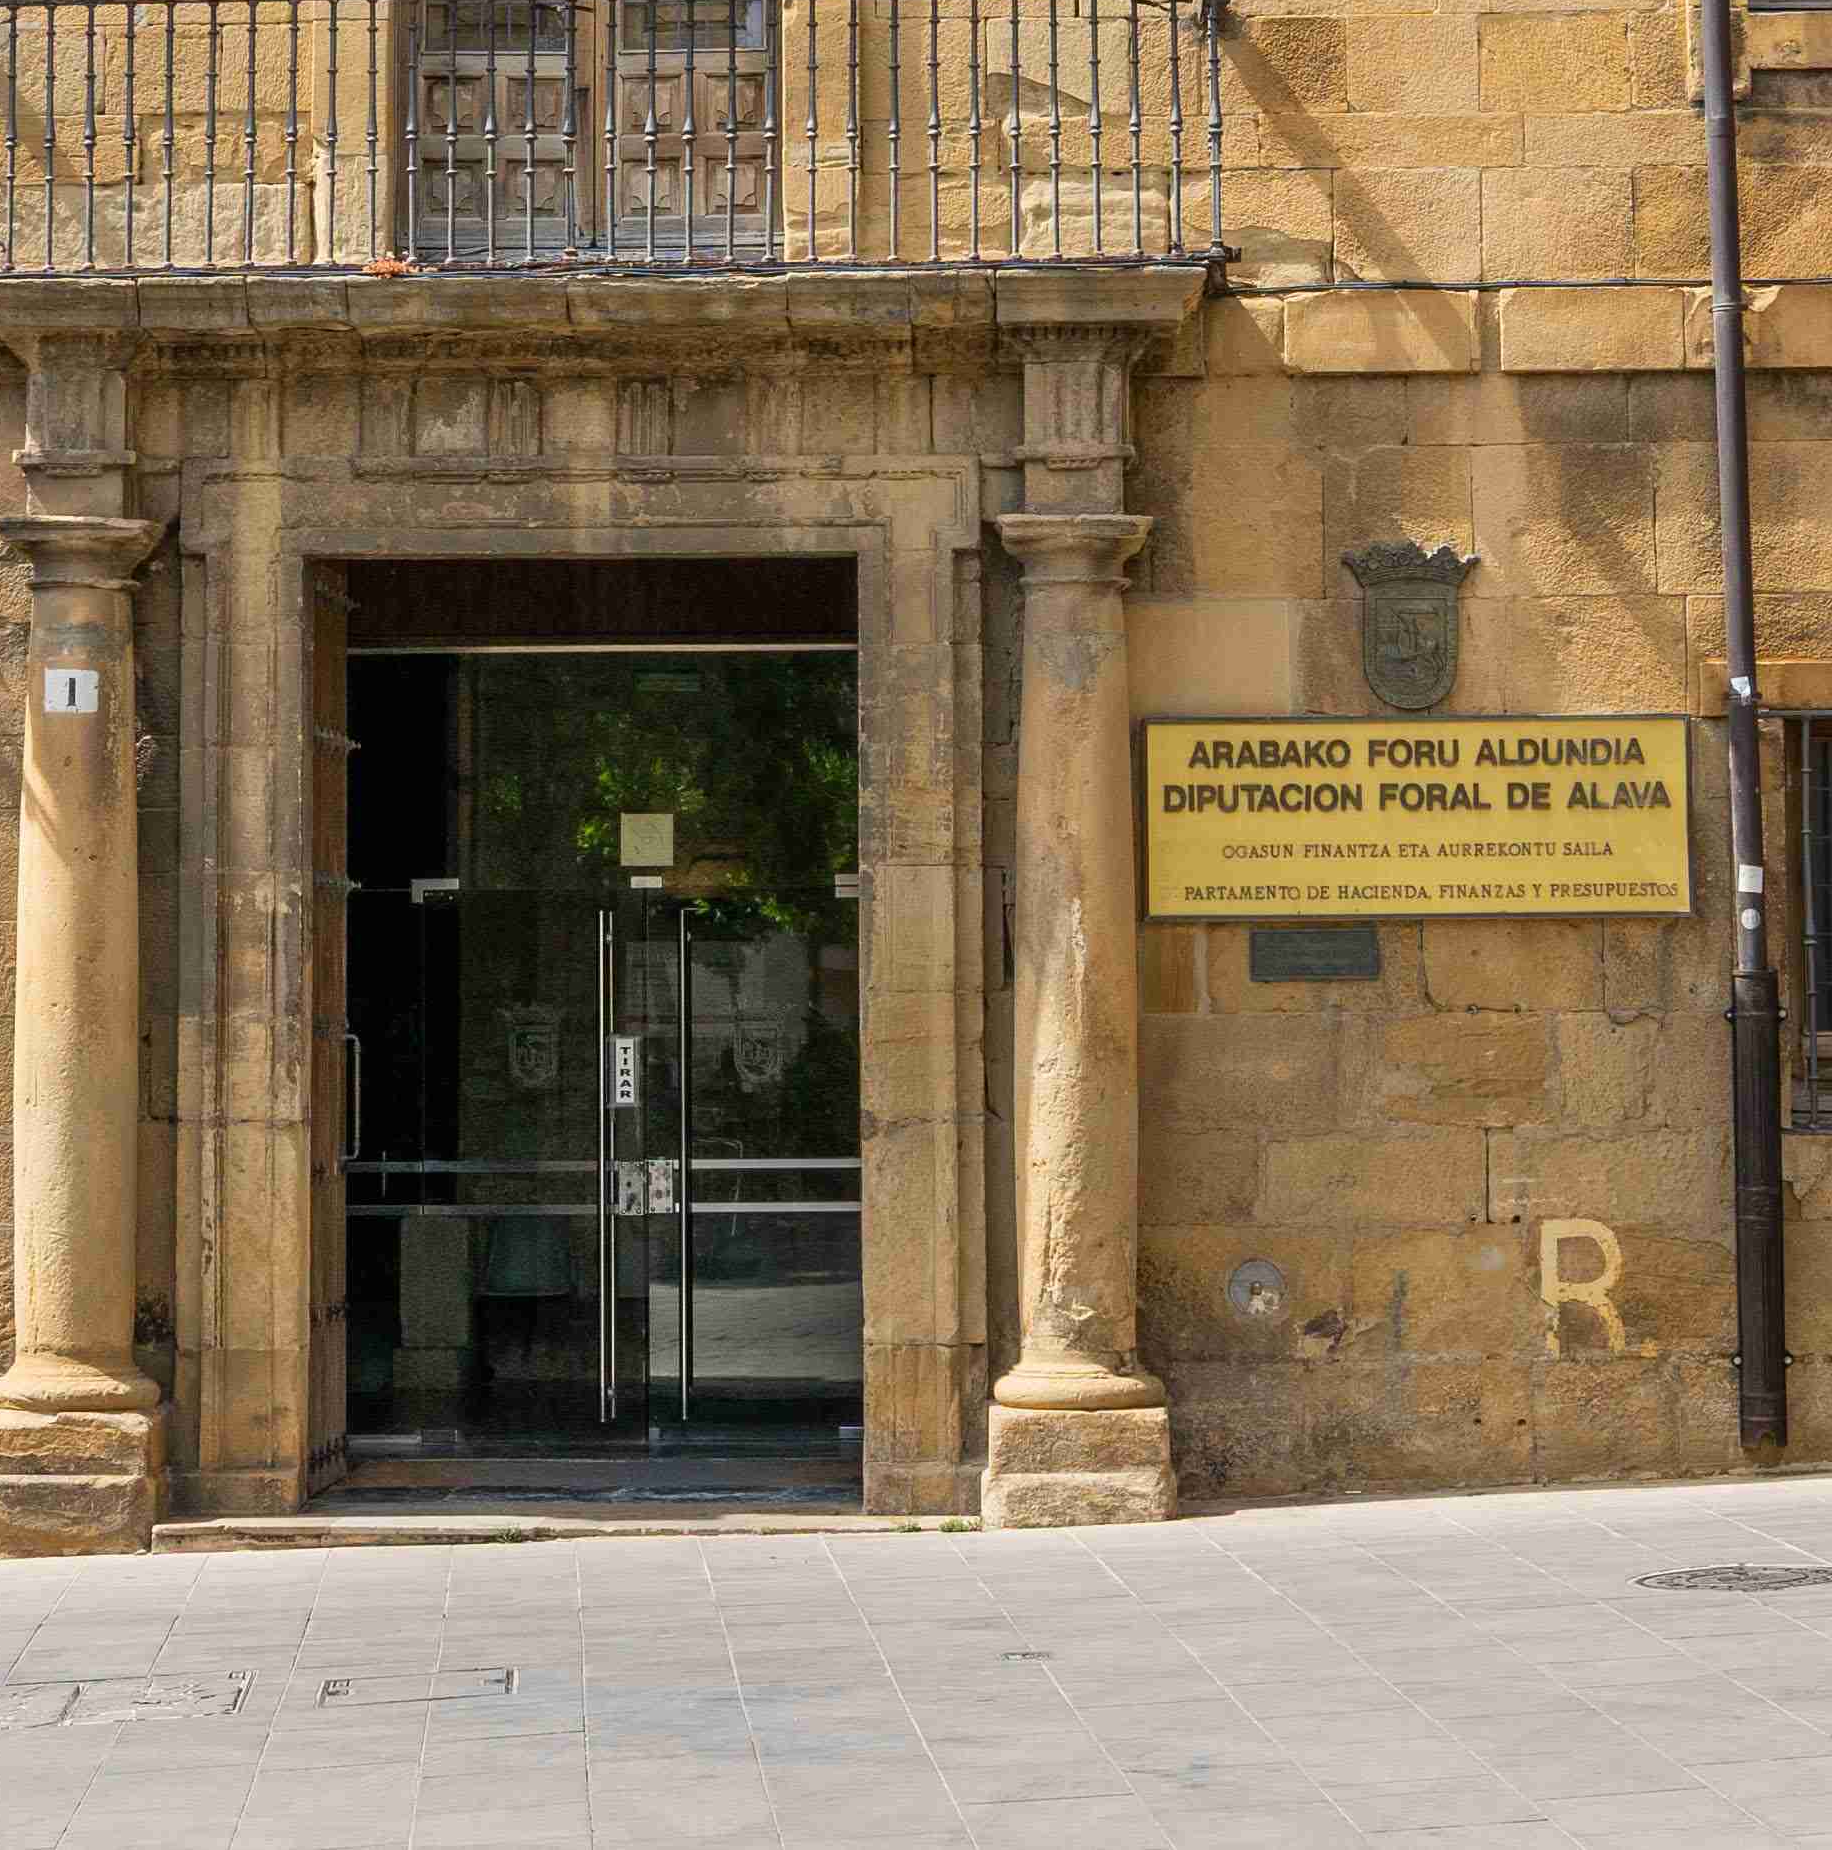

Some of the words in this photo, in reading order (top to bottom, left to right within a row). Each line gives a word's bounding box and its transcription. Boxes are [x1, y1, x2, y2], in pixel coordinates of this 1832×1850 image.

[1188, 738, 1352, 769] ARABAKO
[1368, 738, 1460, 767] FORU
[1475, 737, 1646, 766] ALDUNDIA
[1162, 783, 1364, 813] DIPUTACION
[1378, 782, 1492, 811] FORAL
[1506, 782, 1552, 811] DE
[1566, 781, 1672, 810] ALAVA
[1222, 844, 1295, 860] OGASUN
[1304, 843, 1392, 859] FINANTZA
[1398, 842, 1431, 858] ETA
[1436, 841, 1557, 857] AURREKONTU
[1562, 841, 1614, 856] SAILA
[1184, 885, 1301, 901] PARTAMENTO
[1306, 885, 1330, 900] DE
[1439, 883, 1526, 899] FINANZAS
[1532, 883, 1543, 898] Y
[1550, 882, 1679, 898] PRESUPUESTOS
[619, 1046, 632, 1099] TIRAR
